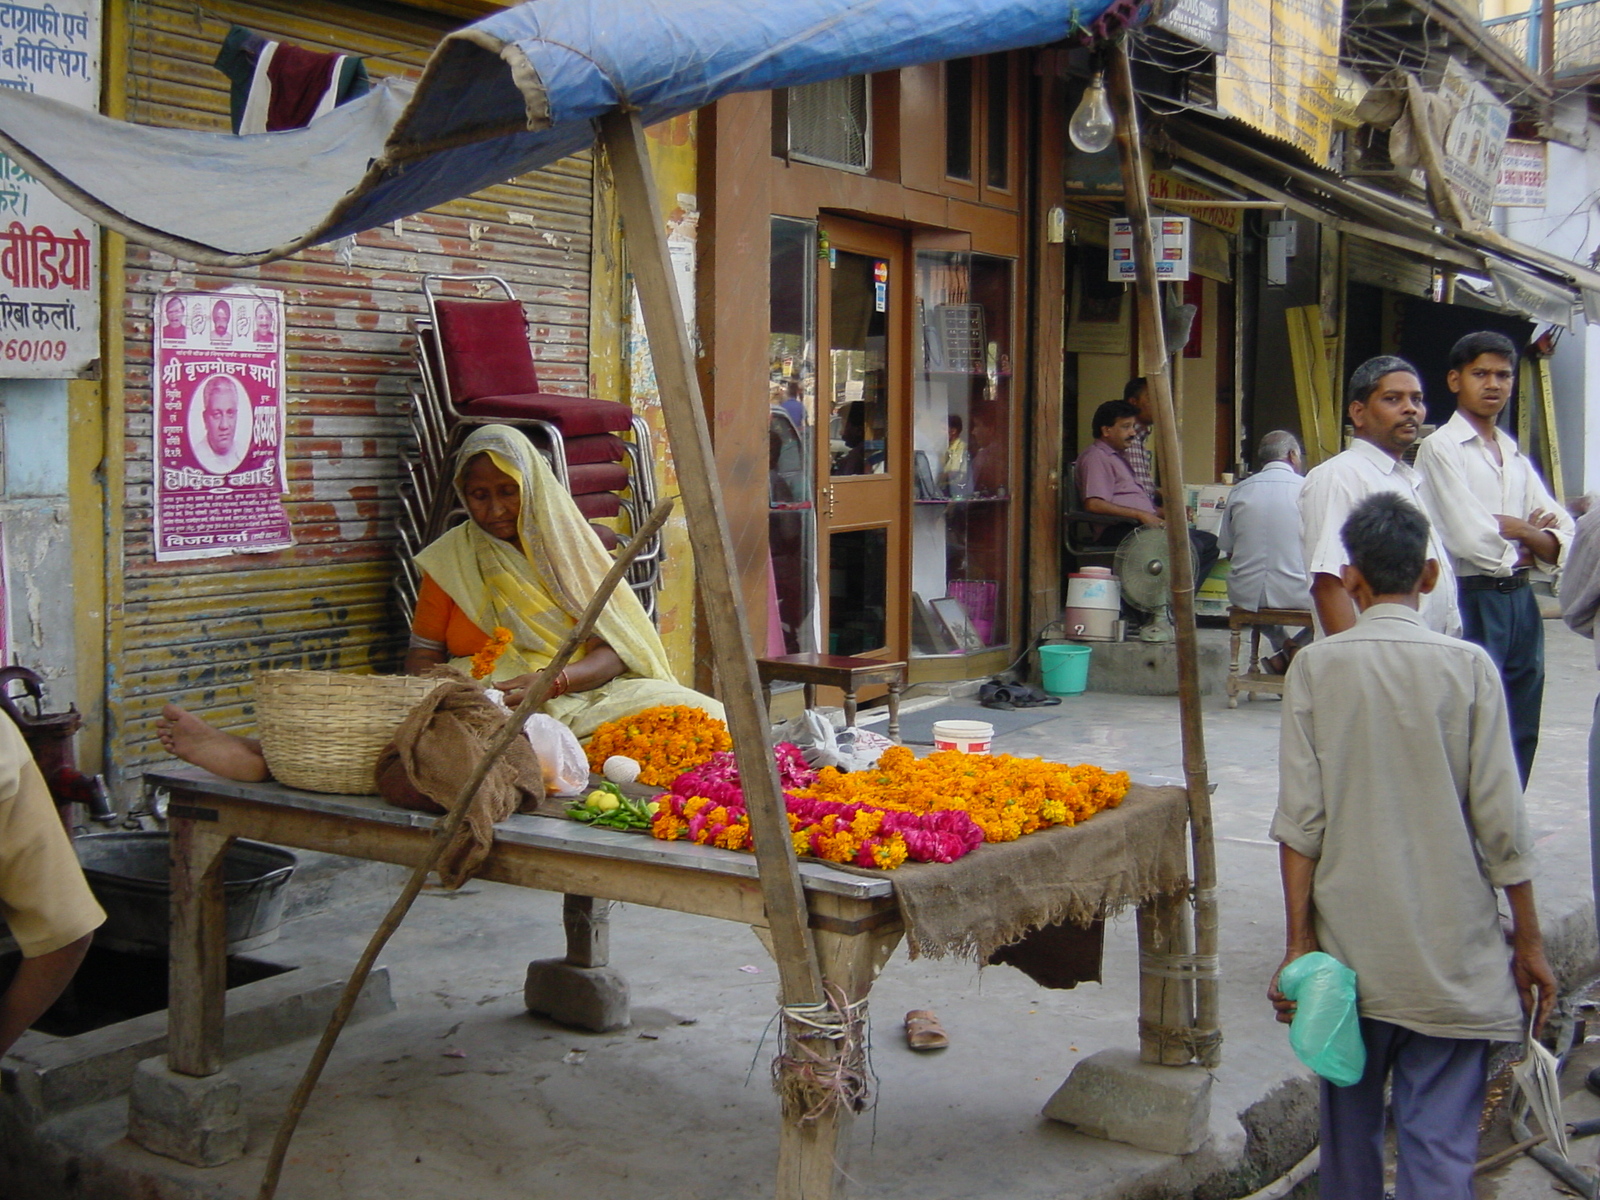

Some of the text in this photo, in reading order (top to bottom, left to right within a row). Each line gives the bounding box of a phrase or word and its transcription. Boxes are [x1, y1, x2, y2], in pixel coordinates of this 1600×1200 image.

[61, 11, 89, 44] एवं
[0, 221, 91, 291] वीडियो
[0, 338, 67, 362] 60109
[162, 357, 277, 389] श्री बृजमोहन शर्मा
[165, 535, 215, 547] विजय
